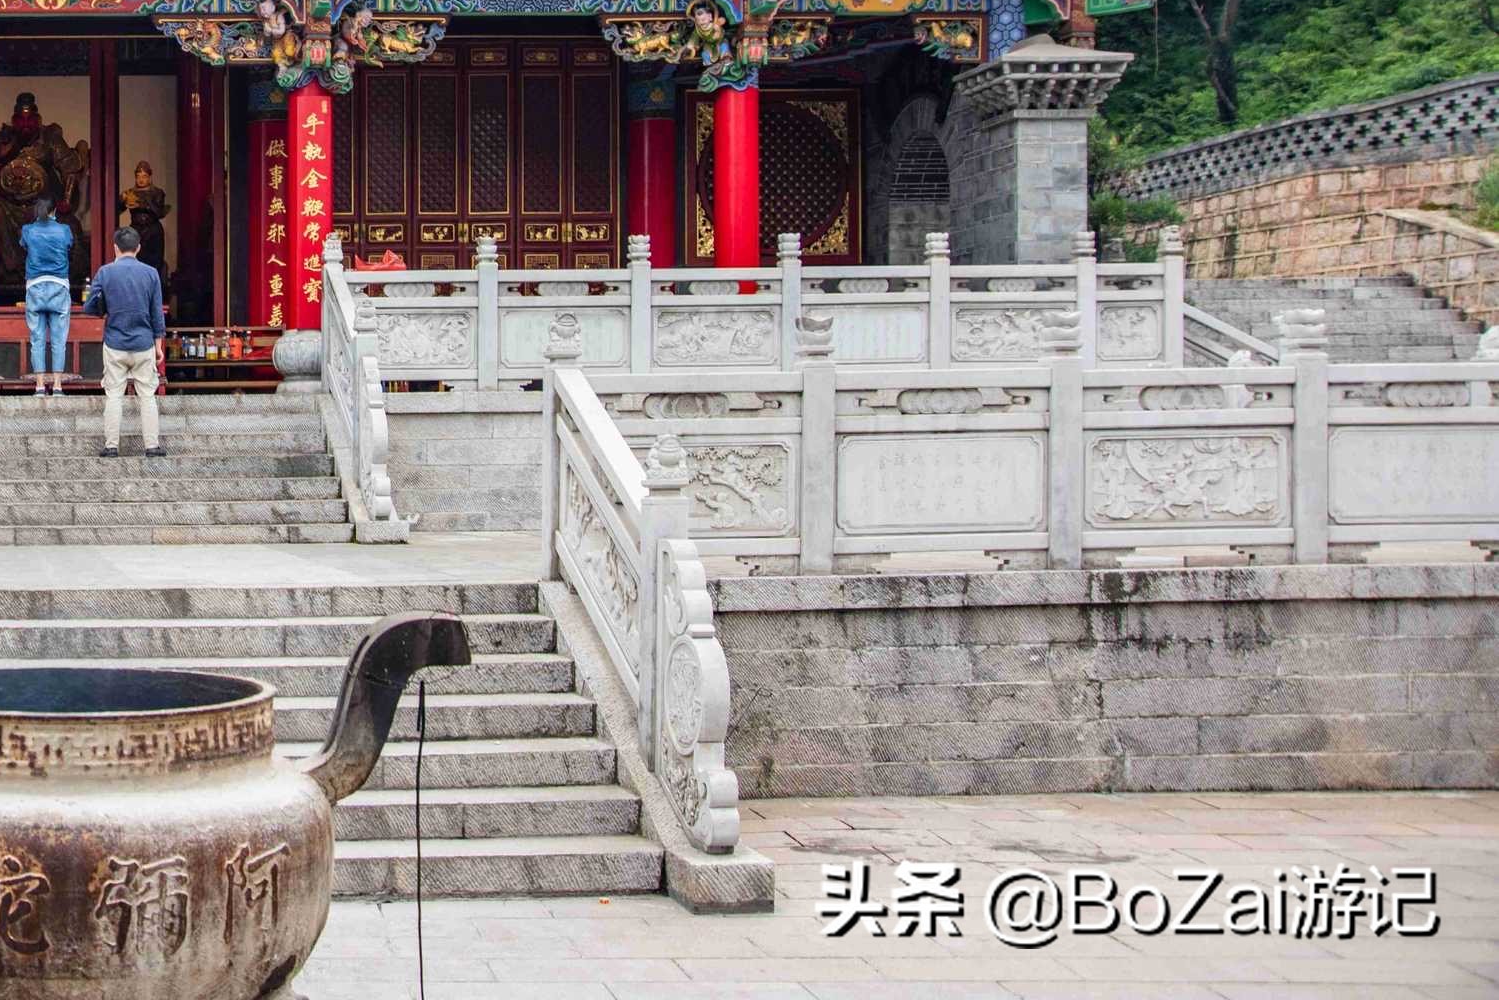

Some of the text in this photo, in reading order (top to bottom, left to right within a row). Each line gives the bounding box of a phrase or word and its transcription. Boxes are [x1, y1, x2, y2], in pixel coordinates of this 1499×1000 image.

[300, 112, 327, 304] 手執金鞭常進寶
